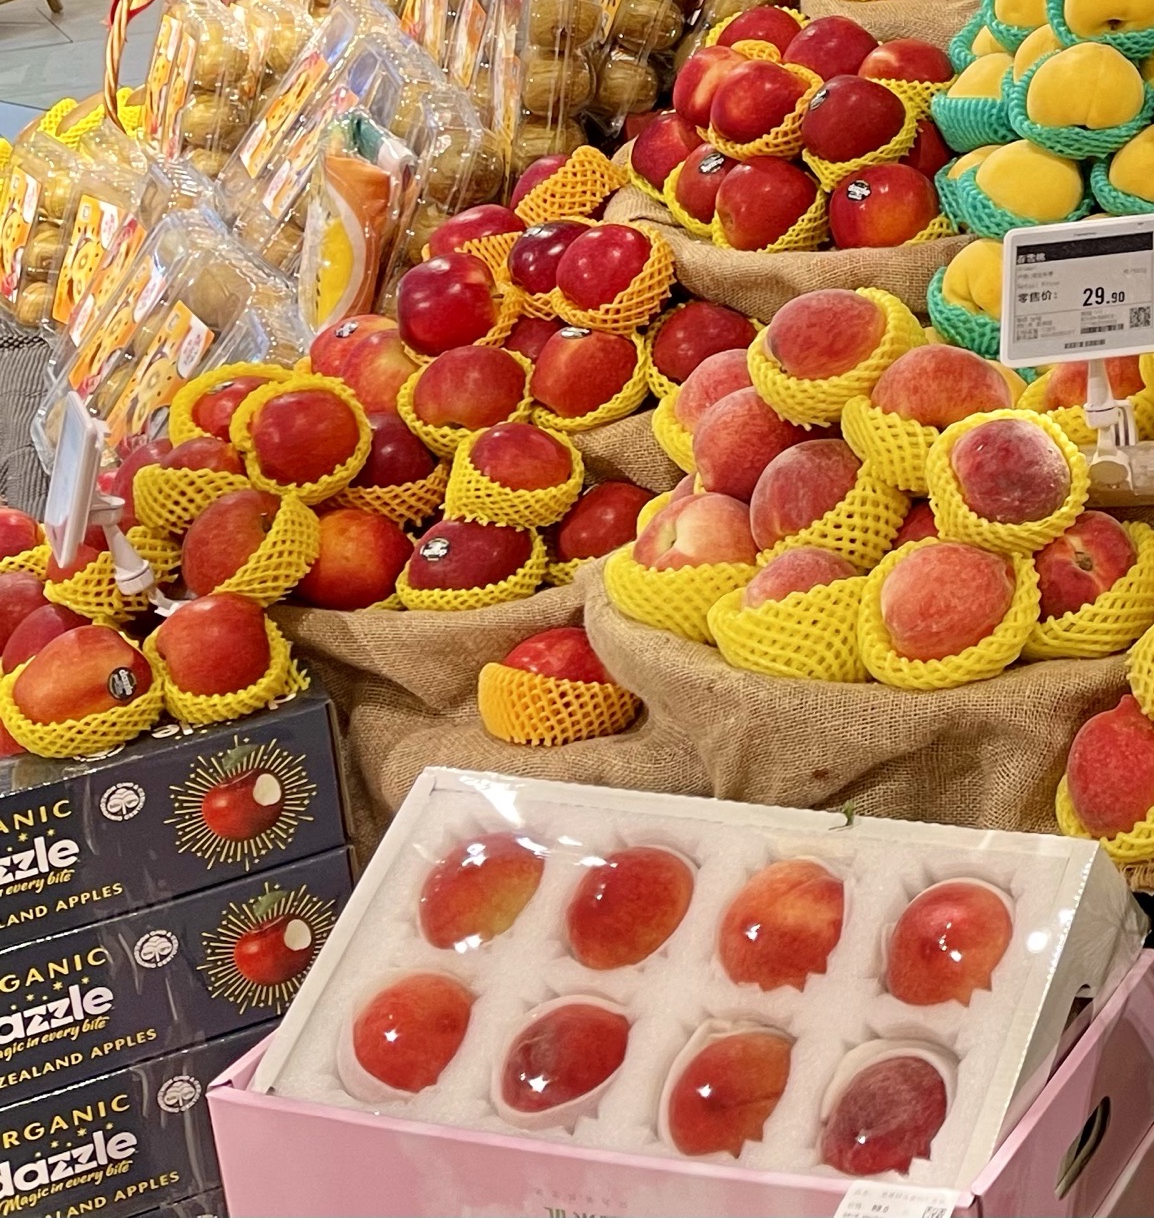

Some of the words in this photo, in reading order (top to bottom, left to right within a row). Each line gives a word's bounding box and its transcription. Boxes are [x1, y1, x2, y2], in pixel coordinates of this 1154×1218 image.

[1082, 286, 1126, 308] 29.90
[6, 877, 45, 894] every
[47, 868, 76, 886] bite
[55, 882, 124, 913] APPLES
[27, 1036, 39, 1048] in
[41, 1024, 80, 1042] every
[82, 1015, 110, 1033] bite
[91, 1028, 158, 1059] APPLES
[1, 1186, 49, 1216] Magic
[50, 1180, 64, 1194] in
[65, 1169, 103, 1187] every
[106, 1159, 134, 1178] bite
[114, 1170, 181, 1203] APPLES
